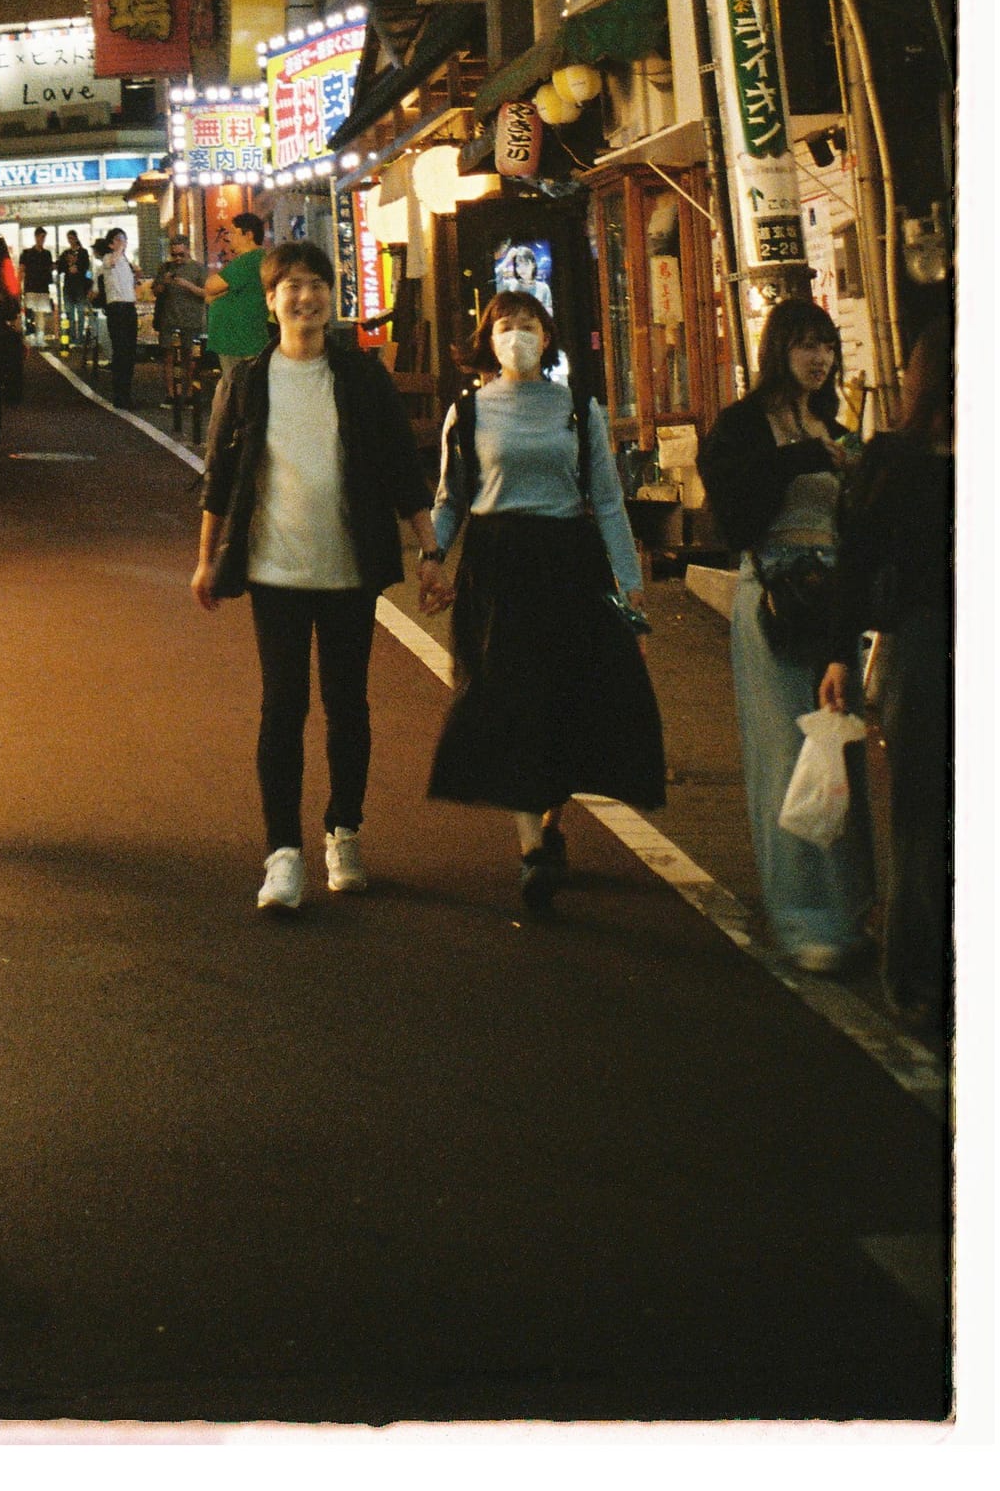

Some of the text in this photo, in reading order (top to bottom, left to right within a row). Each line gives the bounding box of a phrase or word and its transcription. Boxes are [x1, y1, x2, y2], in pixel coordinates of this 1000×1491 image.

[192, 116, 255, 146] 無料
[188, 148, 262, 169] 案内所
